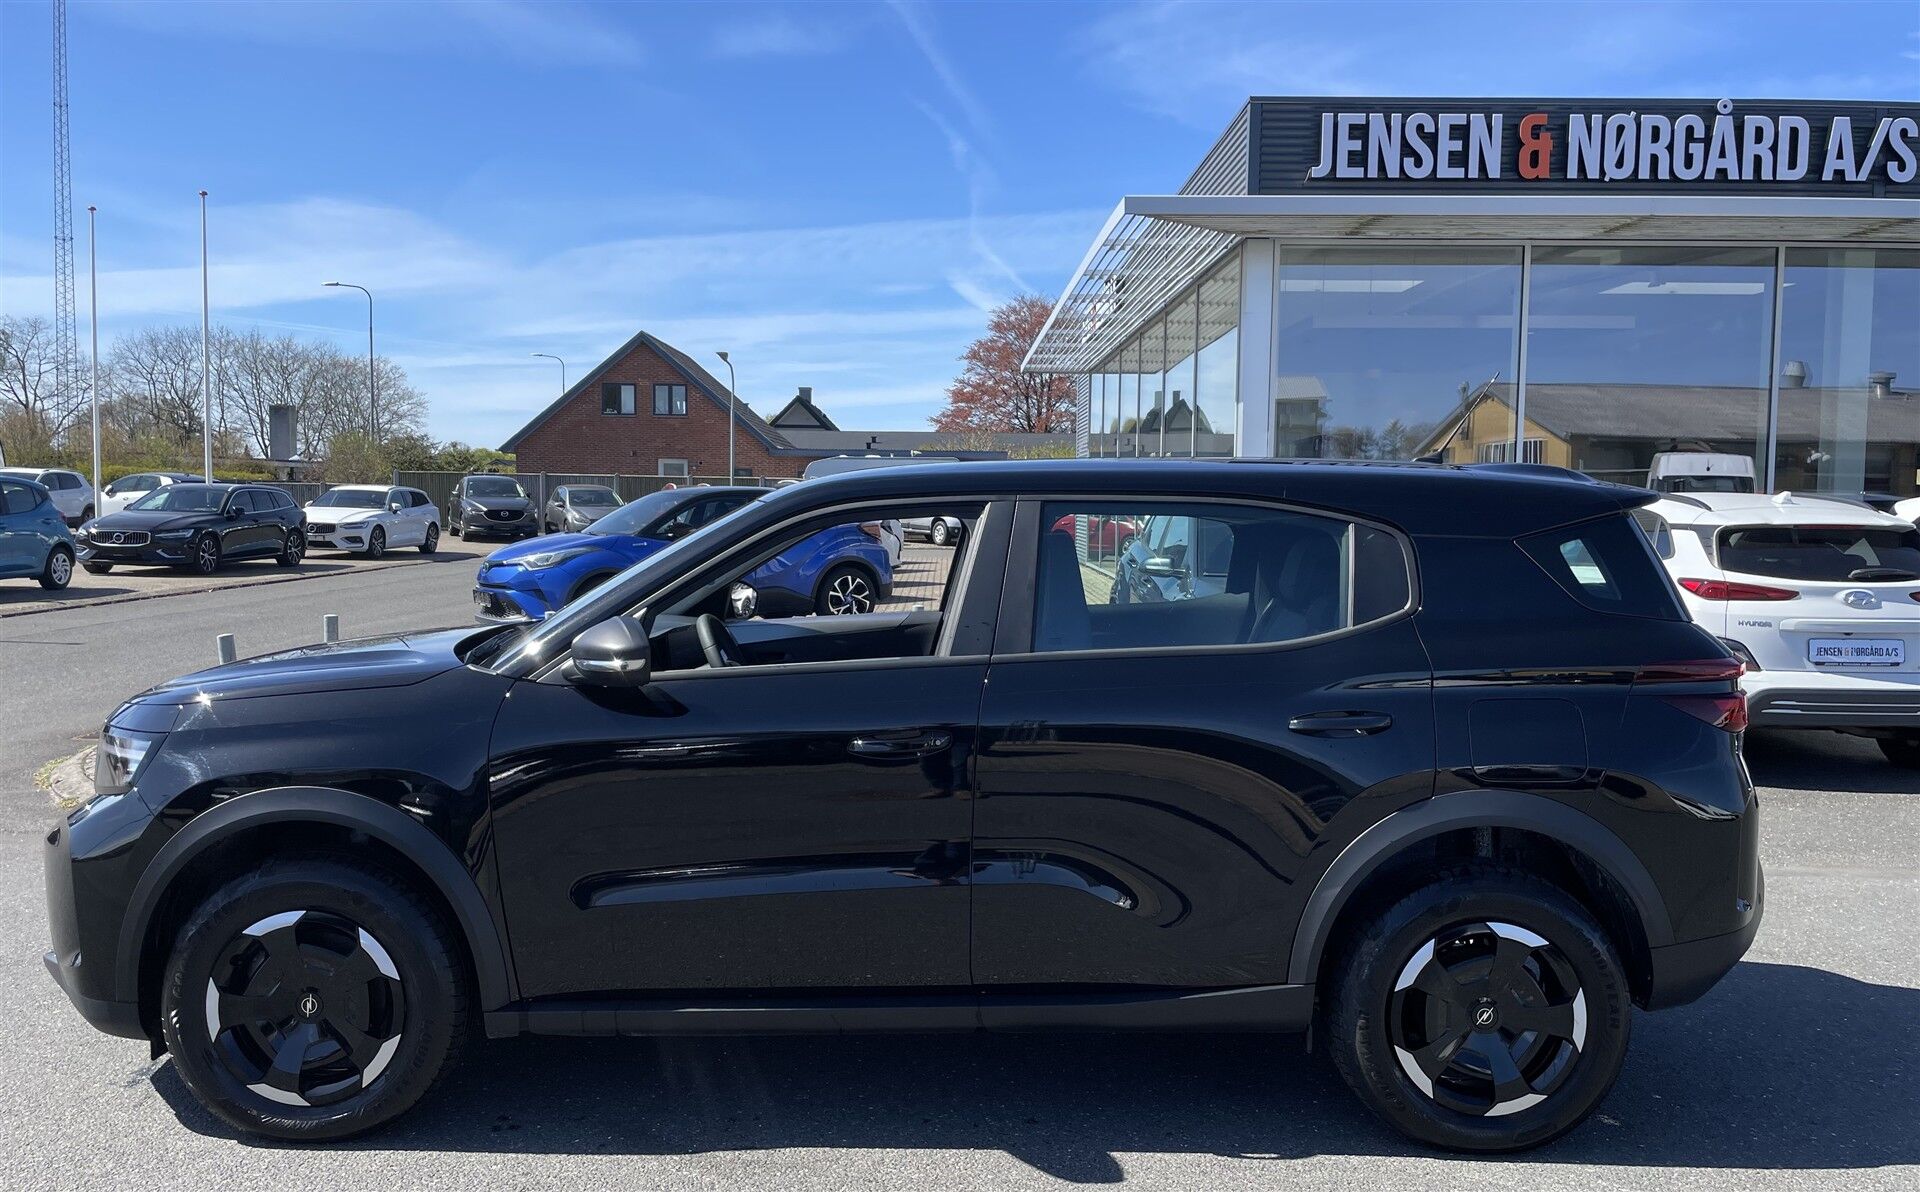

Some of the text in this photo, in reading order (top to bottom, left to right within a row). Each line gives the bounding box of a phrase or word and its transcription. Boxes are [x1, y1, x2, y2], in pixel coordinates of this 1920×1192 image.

[1306, 99, 1919, 182] JENSEN & NØRGÅRD A/S
[1815, 646, 1843, 657] JENSEN
[1885, 647, 1899, 657] A/S
